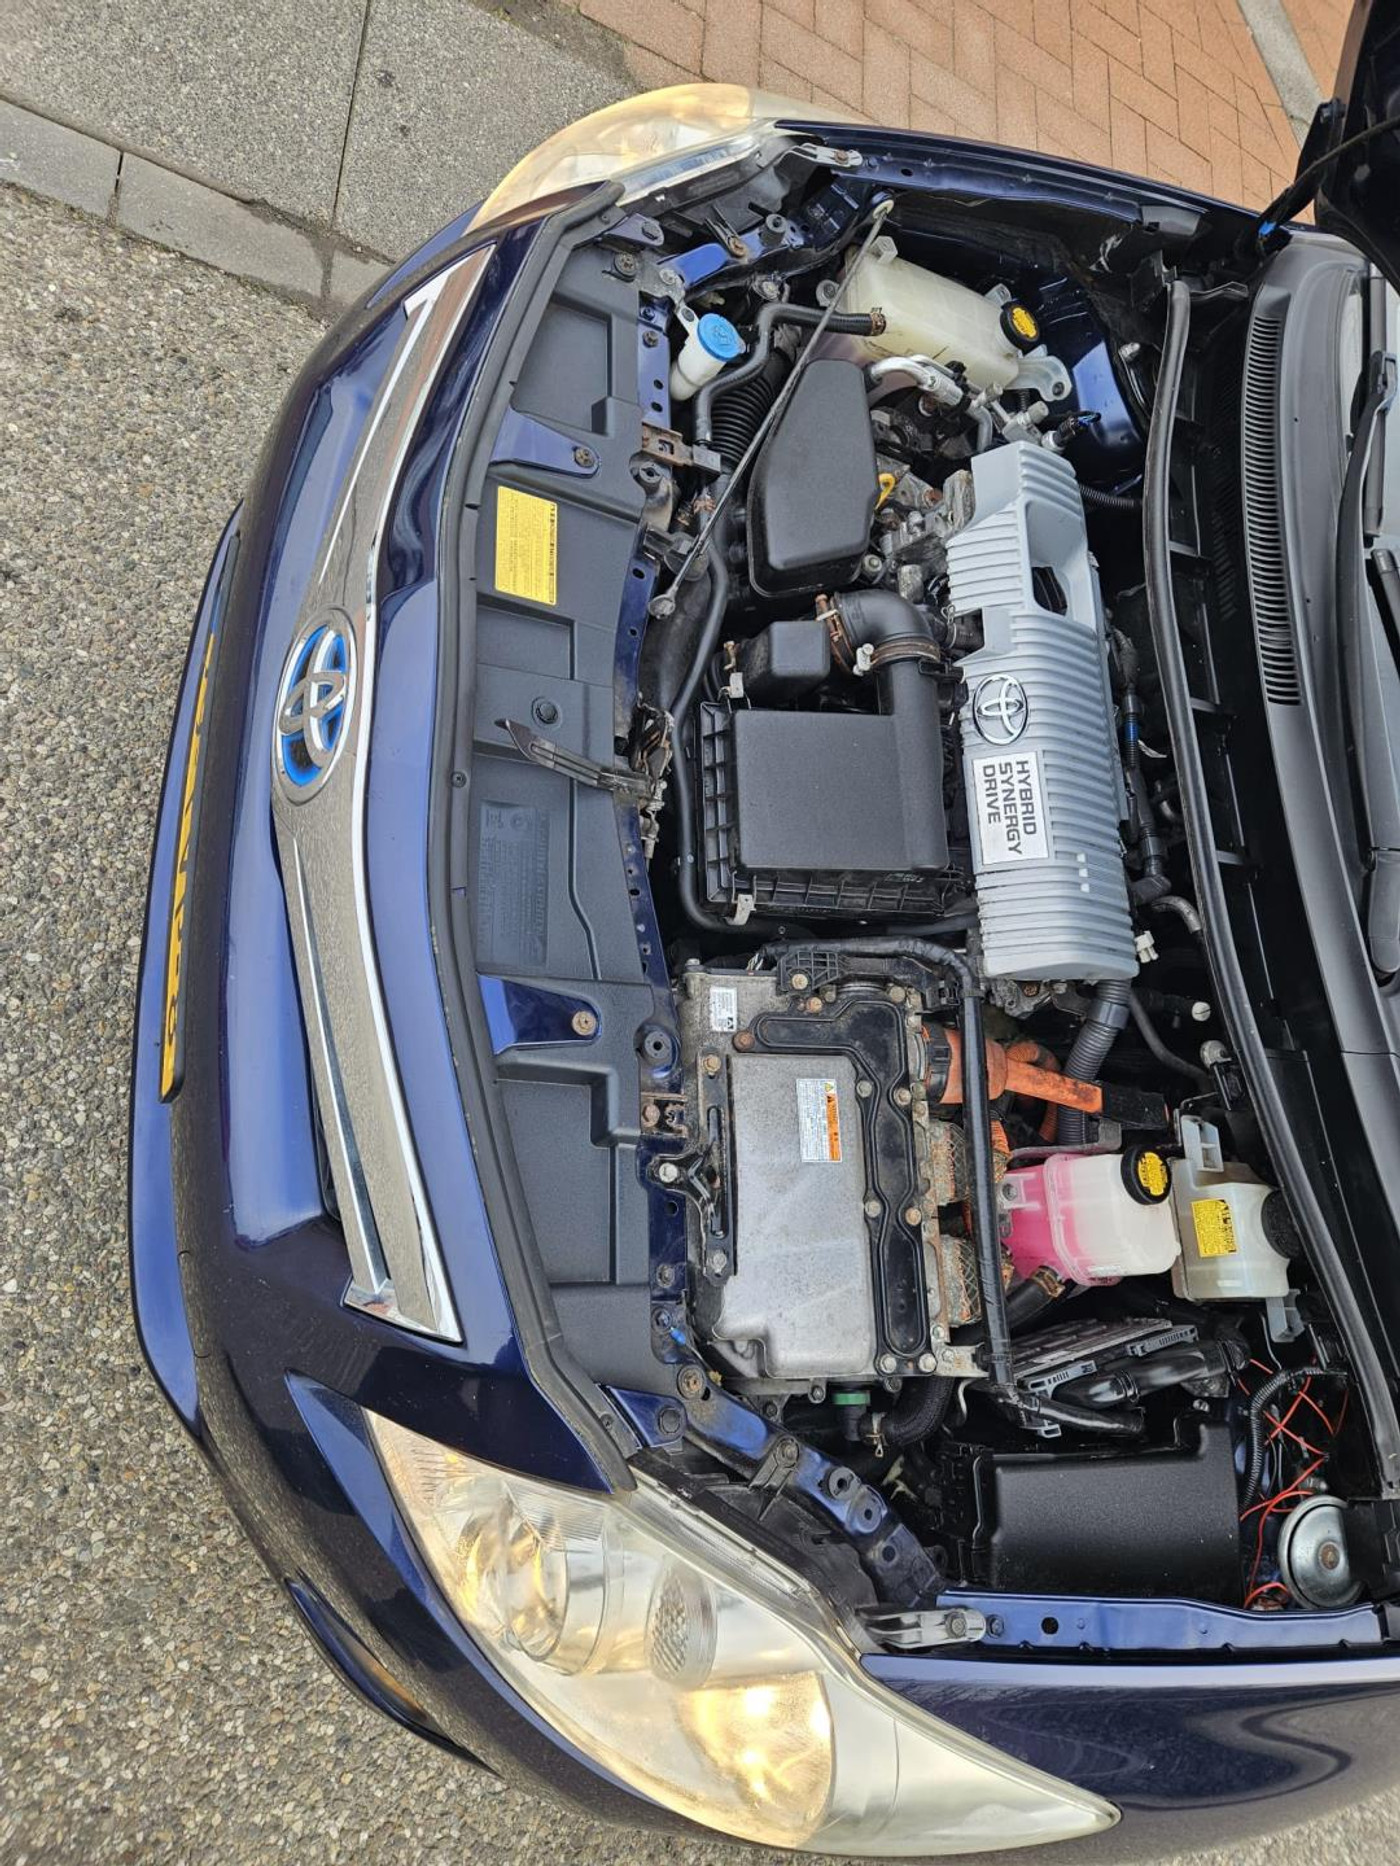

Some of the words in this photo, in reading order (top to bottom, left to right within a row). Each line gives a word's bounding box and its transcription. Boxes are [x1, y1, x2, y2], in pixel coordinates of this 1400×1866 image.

[983, 765, 1001, 825] DRIVE
[1000, 763, 1022, 855] SYNERGY
[1017, 761, 1037, 835] HYBRID
